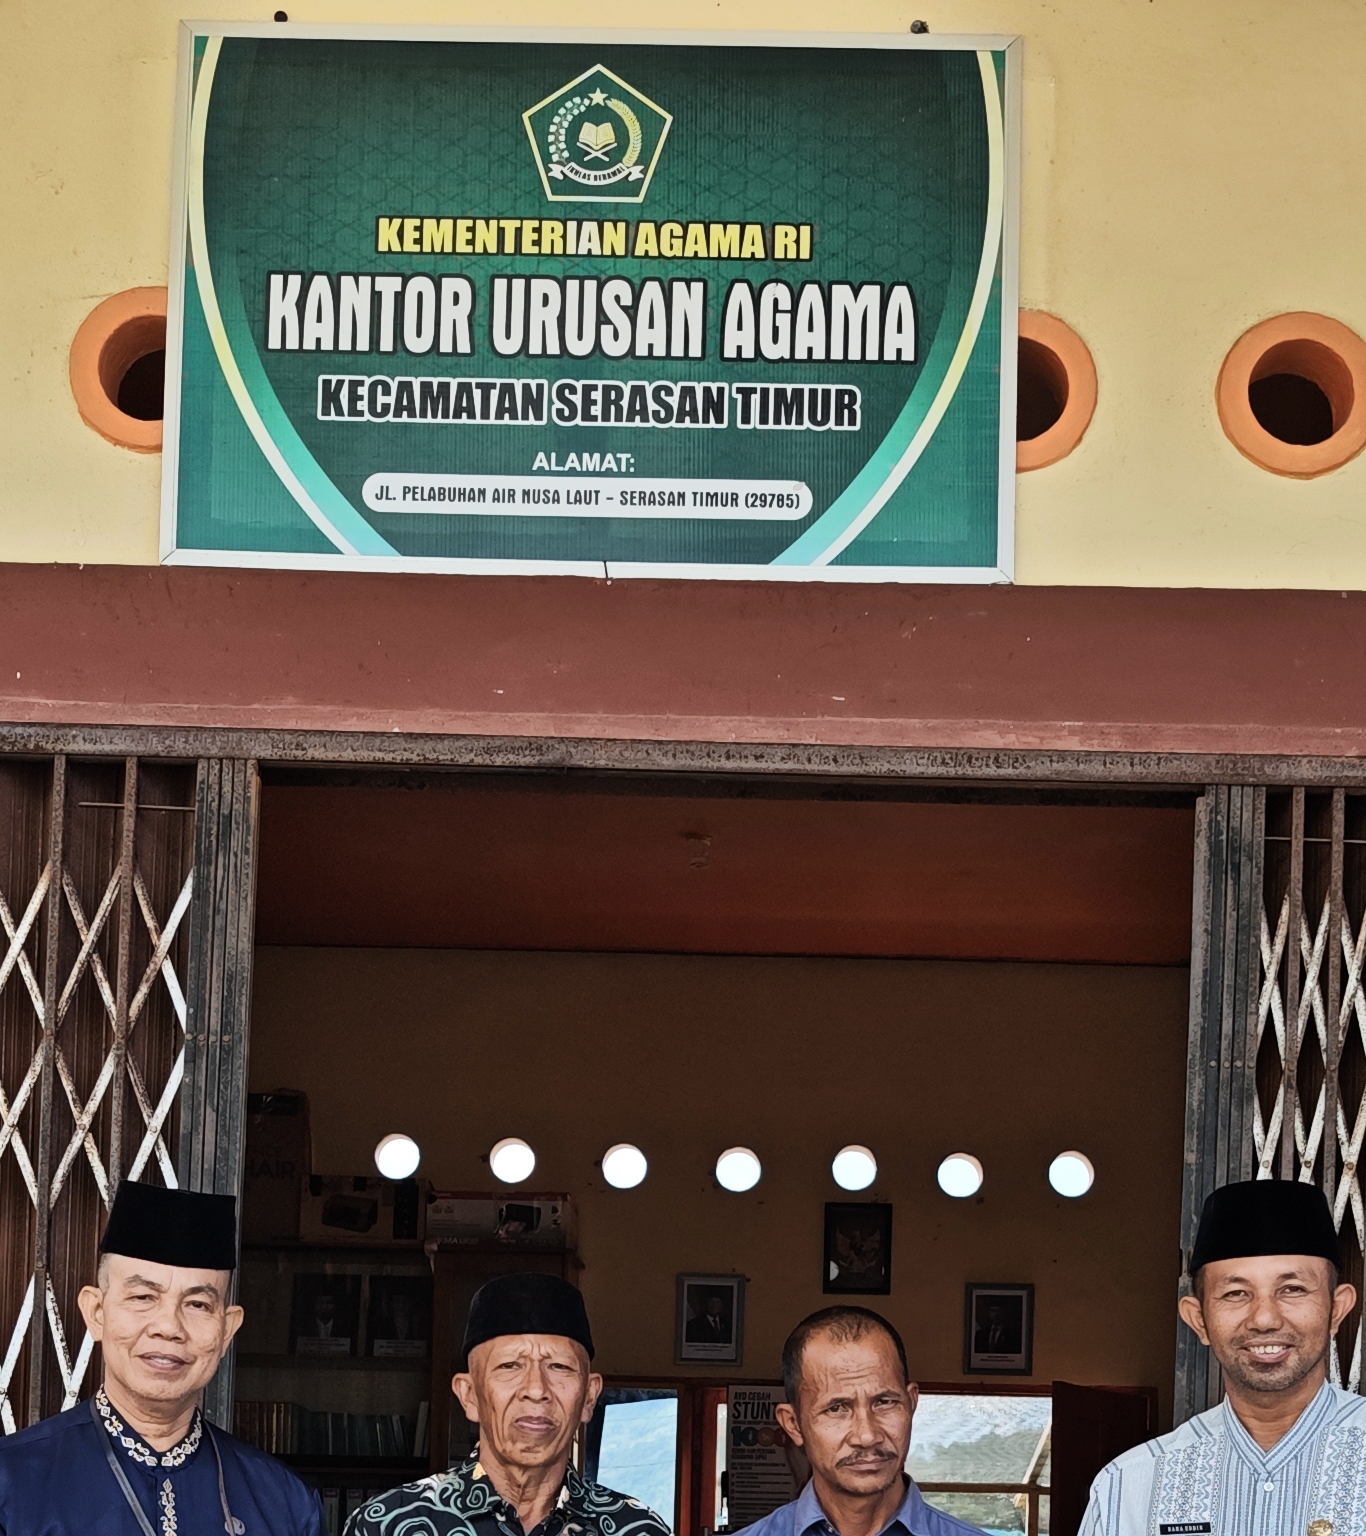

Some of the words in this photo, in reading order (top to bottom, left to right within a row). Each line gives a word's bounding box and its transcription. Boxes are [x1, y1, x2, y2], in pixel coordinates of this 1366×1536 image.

[378, 218, 627, 256] KEMENTERIAN
[636, 222, 764, 260] AGAMA
[775, 224, 812, 260] RI
[268, 274, 472, 354] KANTOR
[492, 278, 704, 358] URUSAN
[723, 283, 917, 361] AGAMA
[320, 379, 544, 424] KECAMATAN
[554, 383, 727, 427] SERASAN
[736, 386, 859, 429] TIMUR
[532, 451, 636, 473] ALAMAT:
[375, 486, 396, 502] JL.
[403, 486, 487, 503] PELABUHAN
[492, 488, 516, 503] AIR
[522, 489, 561, 505] NUSA
[566, 490, 601, 506] LAUT
[620, 490, 687, 507] SERASAN
[691, 491, 740, 508] TIMUR
[744, 493, 801, 510] (29785)
[732, 1402, 777, 1420] STUNT
